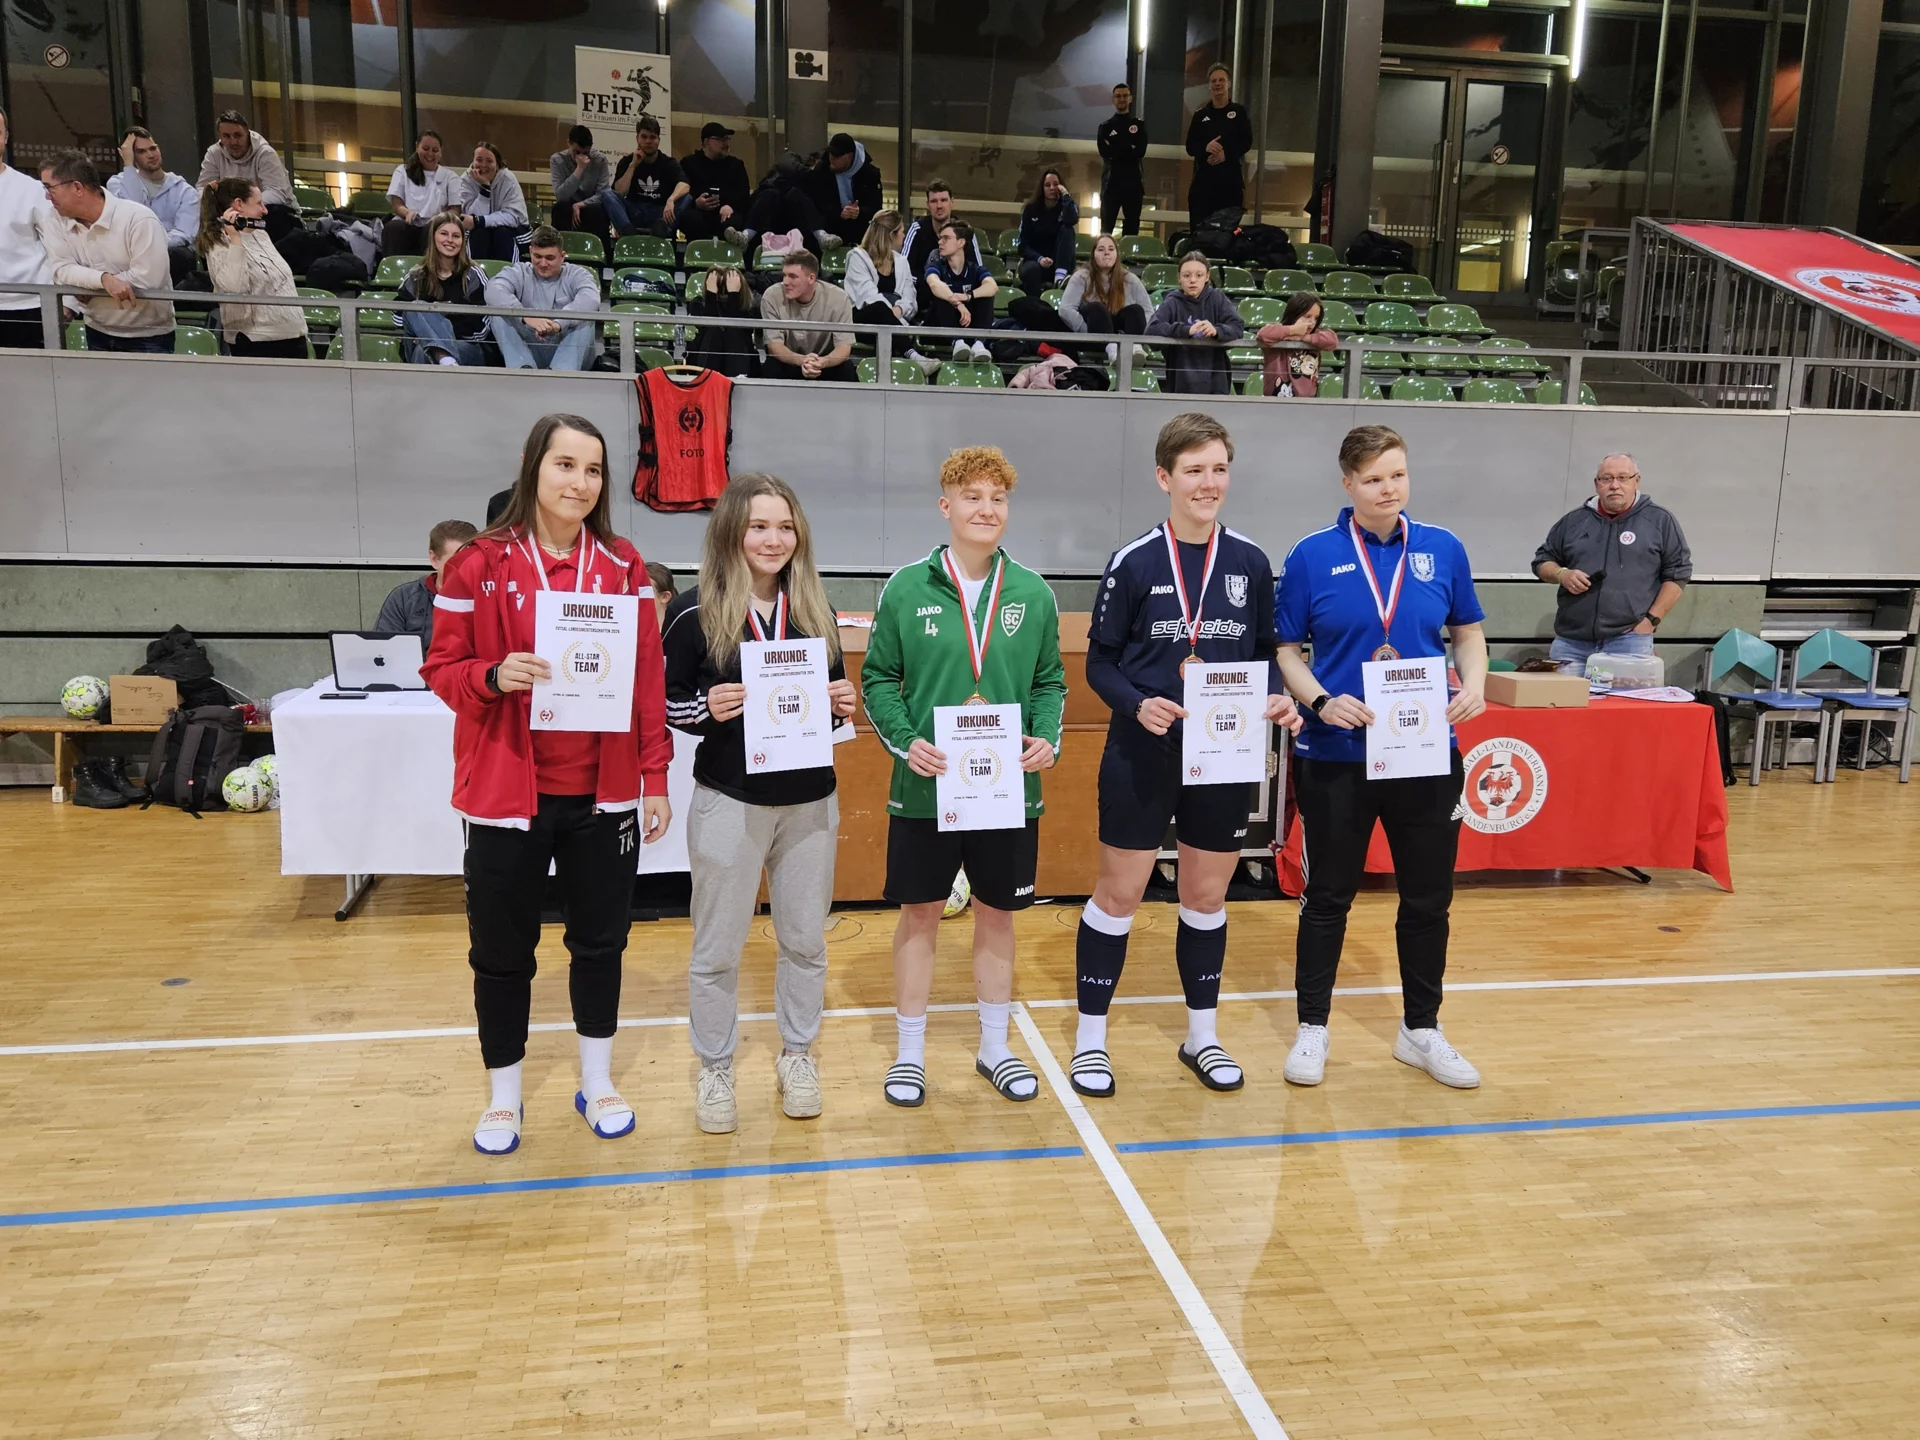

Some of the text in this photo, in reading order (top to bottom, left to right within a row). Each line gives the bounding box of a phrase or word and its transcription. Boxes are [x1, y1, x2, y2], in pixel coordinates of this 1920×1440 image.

[594, 114, 616, 122] Frauen
[680, 448, 705, 458] FOTO
[1331, 563, 1356, 576] JAKO
[1150, 585, 1175, 595] JAKO
[563, 603, 614, 619] URKUNDE
[916, 605, 943, 617] JAKO
[1004, 613, 1020, 626] SC
[924, 618, 939, 637] 4
[764, 650, 808, 664] URKUNDE
[574, 662, 598, 672] TEAM
[1206, 672, 1248, 684] URKUNDE
[1384, 668, 1426, 682] URKUNDE
[778, 703, 800, 714] TEAM
[957, 714, 1000, 728] URKUNDE
[1216, 722, 1236, 731] TEAM
[1398, 717, 1419, 727] TEAM
[970, 766, 992, 776] TEAM
[1014, 884, 1034, 897] JAKO
[1080, 975, 1113, 986] JAKO
[1198, 971, 1223, 981] JAK
[484, 1110, 515, 1119] TRINKEN
